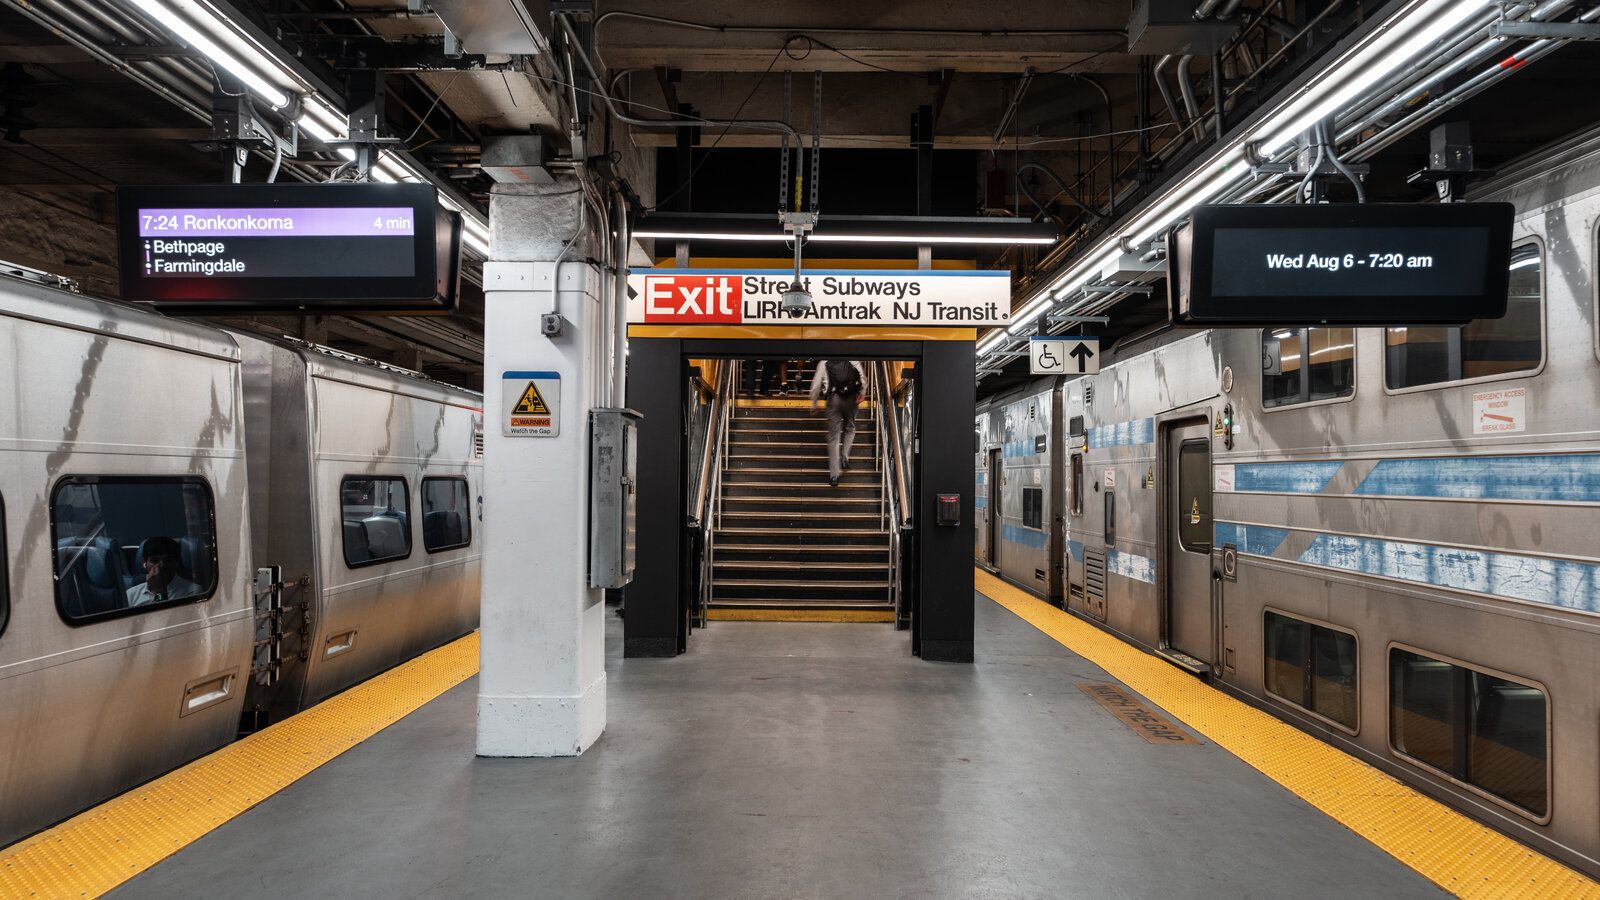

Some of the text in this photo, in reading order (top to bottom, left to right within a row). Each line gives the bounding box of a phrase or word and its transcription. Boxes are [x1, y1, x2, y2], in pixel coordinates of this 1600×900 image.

[142, 215, 411, 230] 7:24 Ronkonkoma 4 min
[153, 240, 225, 256] Bethpage
[154, 259, 246, 275] Farmingdale
[1266, 254, 1304, 268] Wed
[1306, 254, 1340, 271] Aug
[1343, 254, 1354, 268] 6
[1368, 254, 1404, 268] 7:20
[1406, 256, 1433, 268] am
[646, 277, 733, 315] Exit
[744, 276, 921, 299] Stret Subways
[803, 301, 882, 319] Amtrak
[893, 302, 921, 320] NJ
[927, 302, 998, 320] Transit
[1473, 393, 1502, 401] EMERGENCY
[1120, 708, 1159, 722] THE
[1142, 723, 1185, 740] GAP
